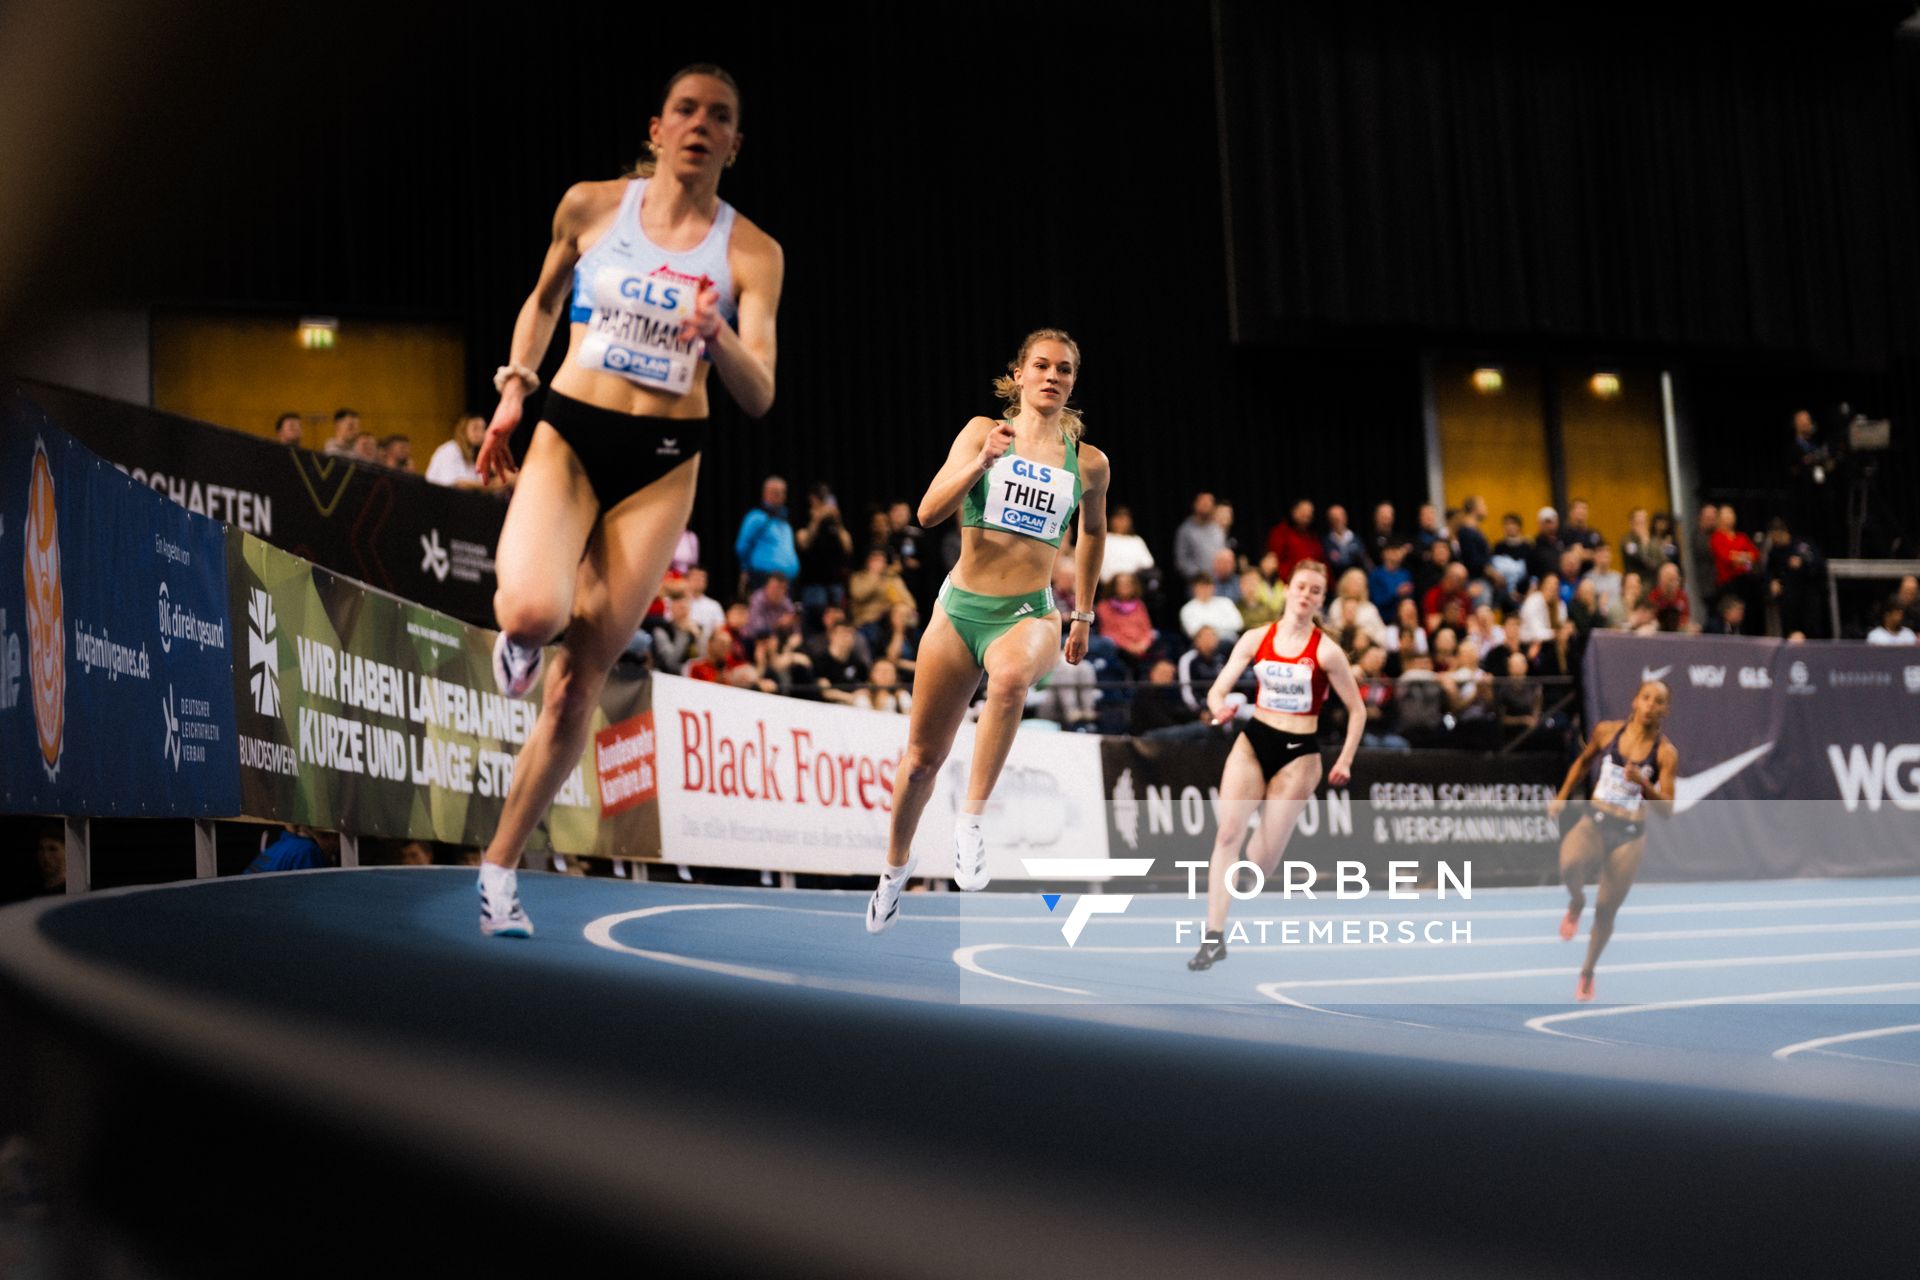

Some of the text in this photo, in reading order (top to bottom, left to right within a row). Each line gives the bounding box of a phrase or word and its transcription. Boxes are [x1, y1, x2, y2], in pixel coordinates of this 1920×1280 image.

[1004, 480, 1056, 515] THIEL
[1021, 514, 1044, 528] PLAN
[172, 603, 197, 640] direkt
[197, 617, 224, 651] gesund
[75, 618, 150, 682] bigfamilygames.de
[181, 698, 210, 717] DEUTSCHER
[297, 635, 537, 745] WIR HABEN LAUFBAHNEN
[181, 721, 220, 741] LEICHTATHLETIK
[299, 706, 364, 774] KURZE
[365, 723, 407, 782] UND
[182, 745, 206, 762] VERBAND
[239, 734, 300, 777] BUNDESWEHR
[678, 709, 782, 801] Black
[1370, 782, 1558, 811] GEGEN SCHMERZEN
[1373, 816, 1560, 844] & VERSPANNUNGEN
